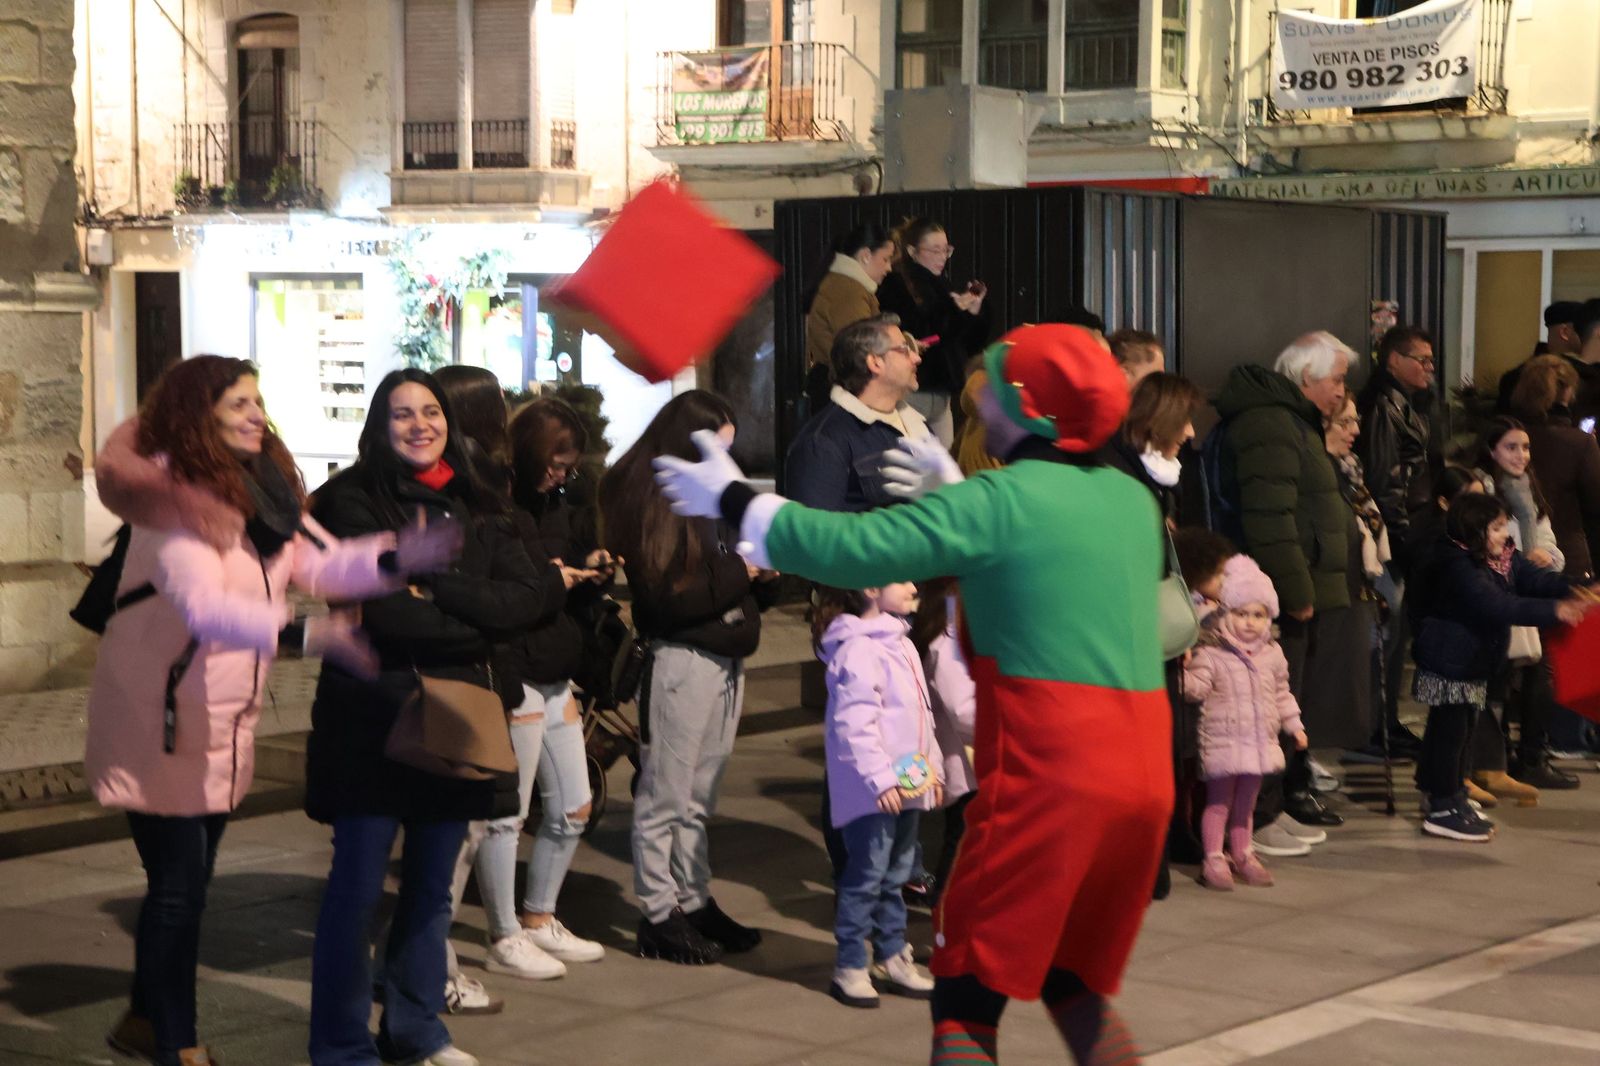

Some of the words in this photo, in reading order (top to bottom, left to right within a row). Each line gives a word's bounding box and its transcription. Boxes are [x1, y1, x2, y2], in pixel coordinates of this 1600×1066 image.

[1284, 22, 1355, 38] SUAVIS
[1313, 51, 1361, 66] VENTA
[1364, 49, 1386, 63] DE
[1391, 41, 1440, 60] PISOS
[1279, 69, 1337, 91] 980
[1346, 64, 1405, 88] 982
[1416, 56, 1469, 82] 303
[675, 93, 701, 112] LOS
[680, 123, 705, 139] 99
[1213, 181, 1314, 199] MATERIAL
[1511, 172, 1600, 192] ARTICU
